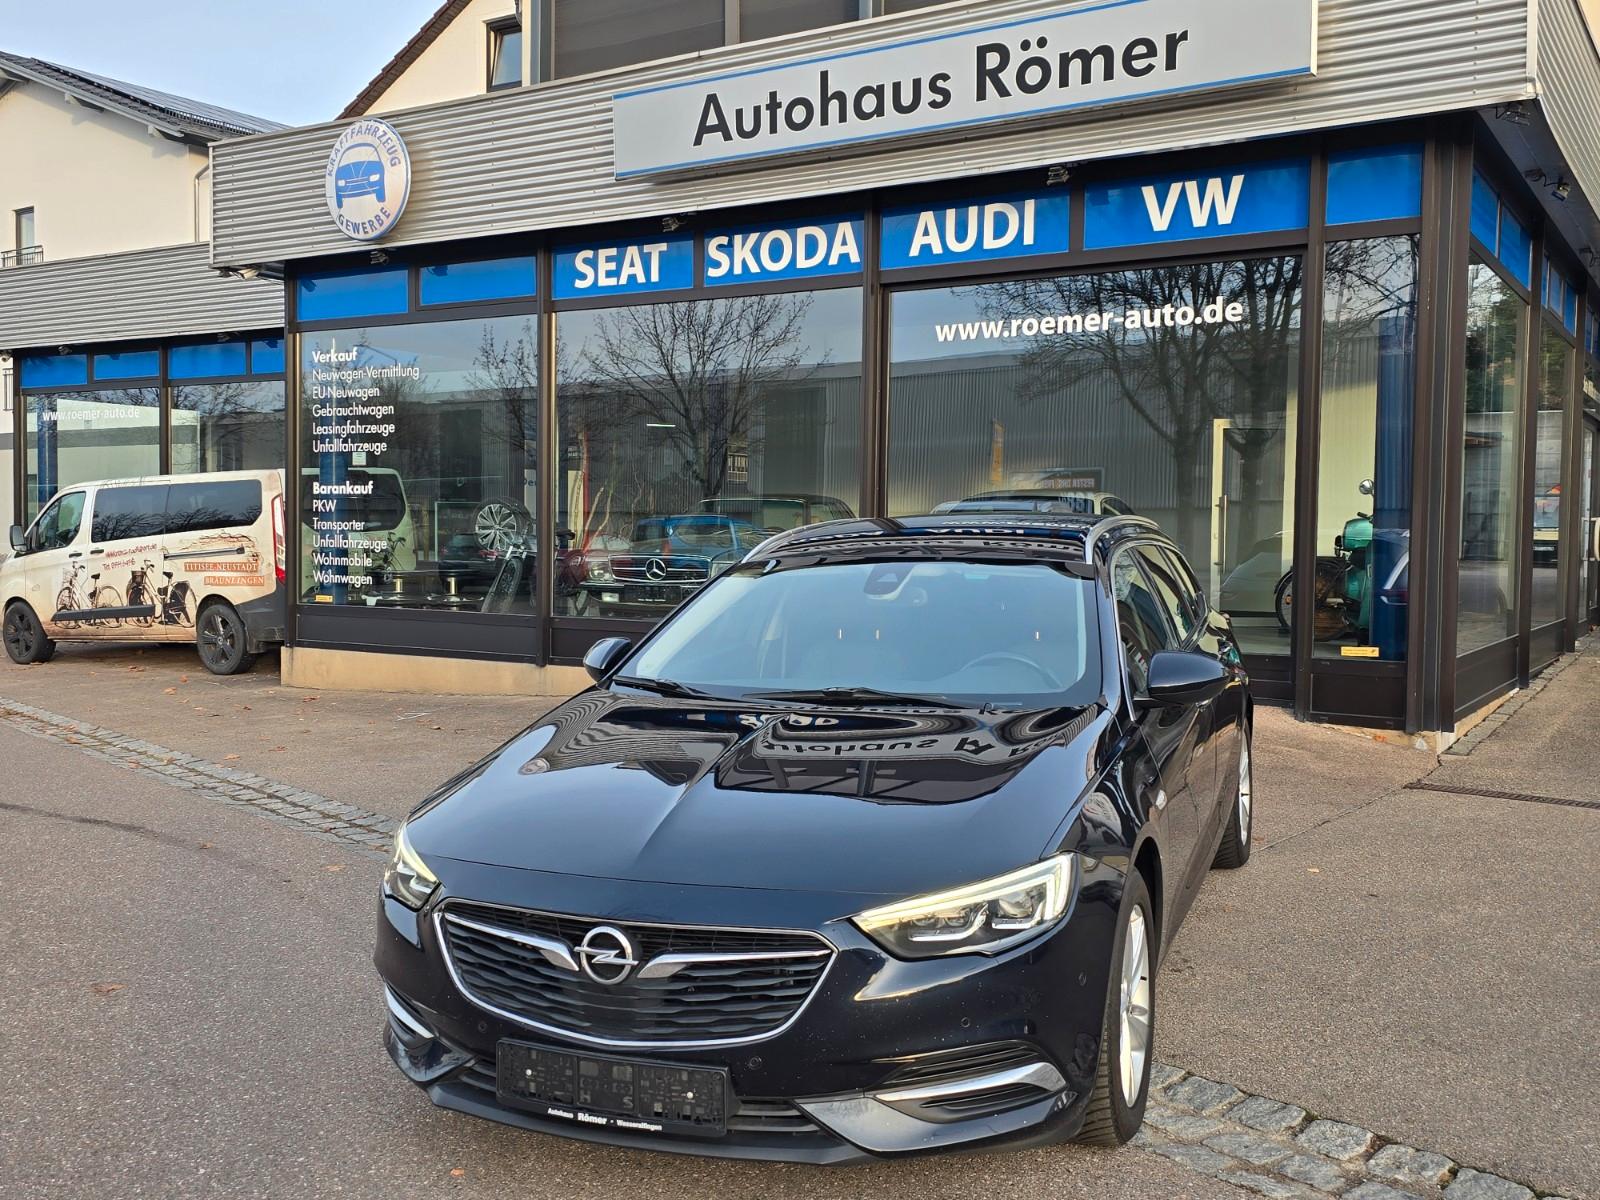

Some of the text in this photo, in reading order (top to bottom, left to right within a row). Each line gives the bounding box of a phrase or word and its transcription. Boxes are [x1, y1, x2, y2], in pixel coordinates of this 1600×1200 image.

[693, 29, 1189, 147] Autohaus Römer
[327, 123, 401, 177] KRAFTFAHRZEUG
[1141, 174, 1245, 232] VW
[338, 206, 391, 235] GEWERBE
[909, 198, 1035, 257] AUDI
[707, 221, 860, 278] SKODA
[574, 242, 667, 289] SEAT
[935, 296, 1243, 342] www.roemer-auto.de
[312, 347, 358, 362] Verkauf
[312, 363, 420, 383] Neuwagen-Vermittlung
[312, 386, 380, 400] EU-Neuwagen
[42, 407, 140, 421] www.roemer-auto.de
[312, 402, 395, 419] Gebrauchtwagen
[312, 420, 396, 438] Leasingfahrzeuge
[312, 438, 388, 456] Unfallfahrzeuge
[312, 480, 374, 495] Barankauf
[312, 499, 337, 512] PKW
[312, 517, 366, 533] Transporter
[312, 534, 388, 553] Unfallfahrzeuge
[312, 552, 373, 567] Wohnmobile
[312, 569, 373, 588] Wohnwagen
[577, 1112, 608, 1125] Römer
